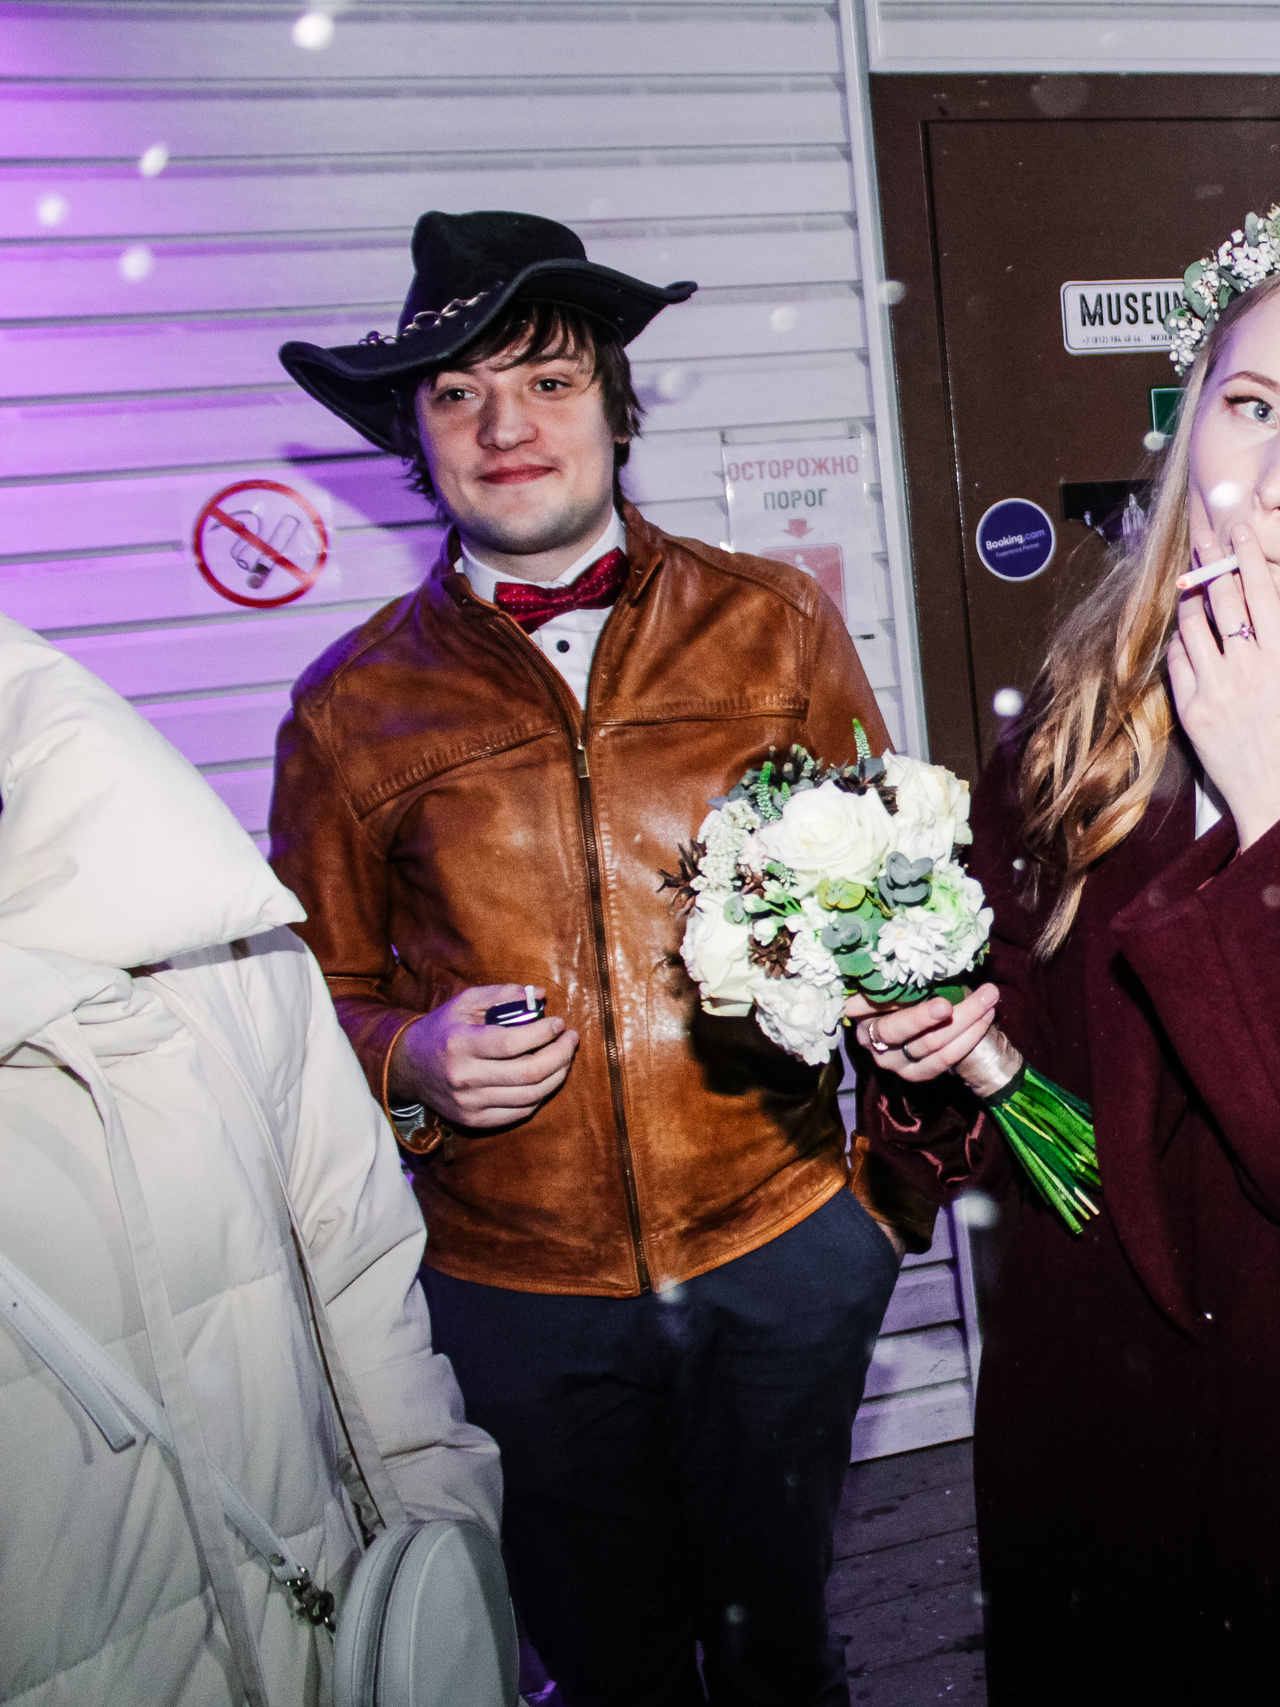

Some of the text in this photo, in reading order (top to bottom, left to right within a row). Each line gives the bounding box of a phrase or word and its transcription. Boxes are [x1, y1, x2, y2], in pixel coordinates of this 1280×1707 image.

[727, 455, 859, 482] ОСТОРОЖНО
[763, 488, 828, 510] ПОРОГ
[985, 529, 1046, 550] Booking.com
